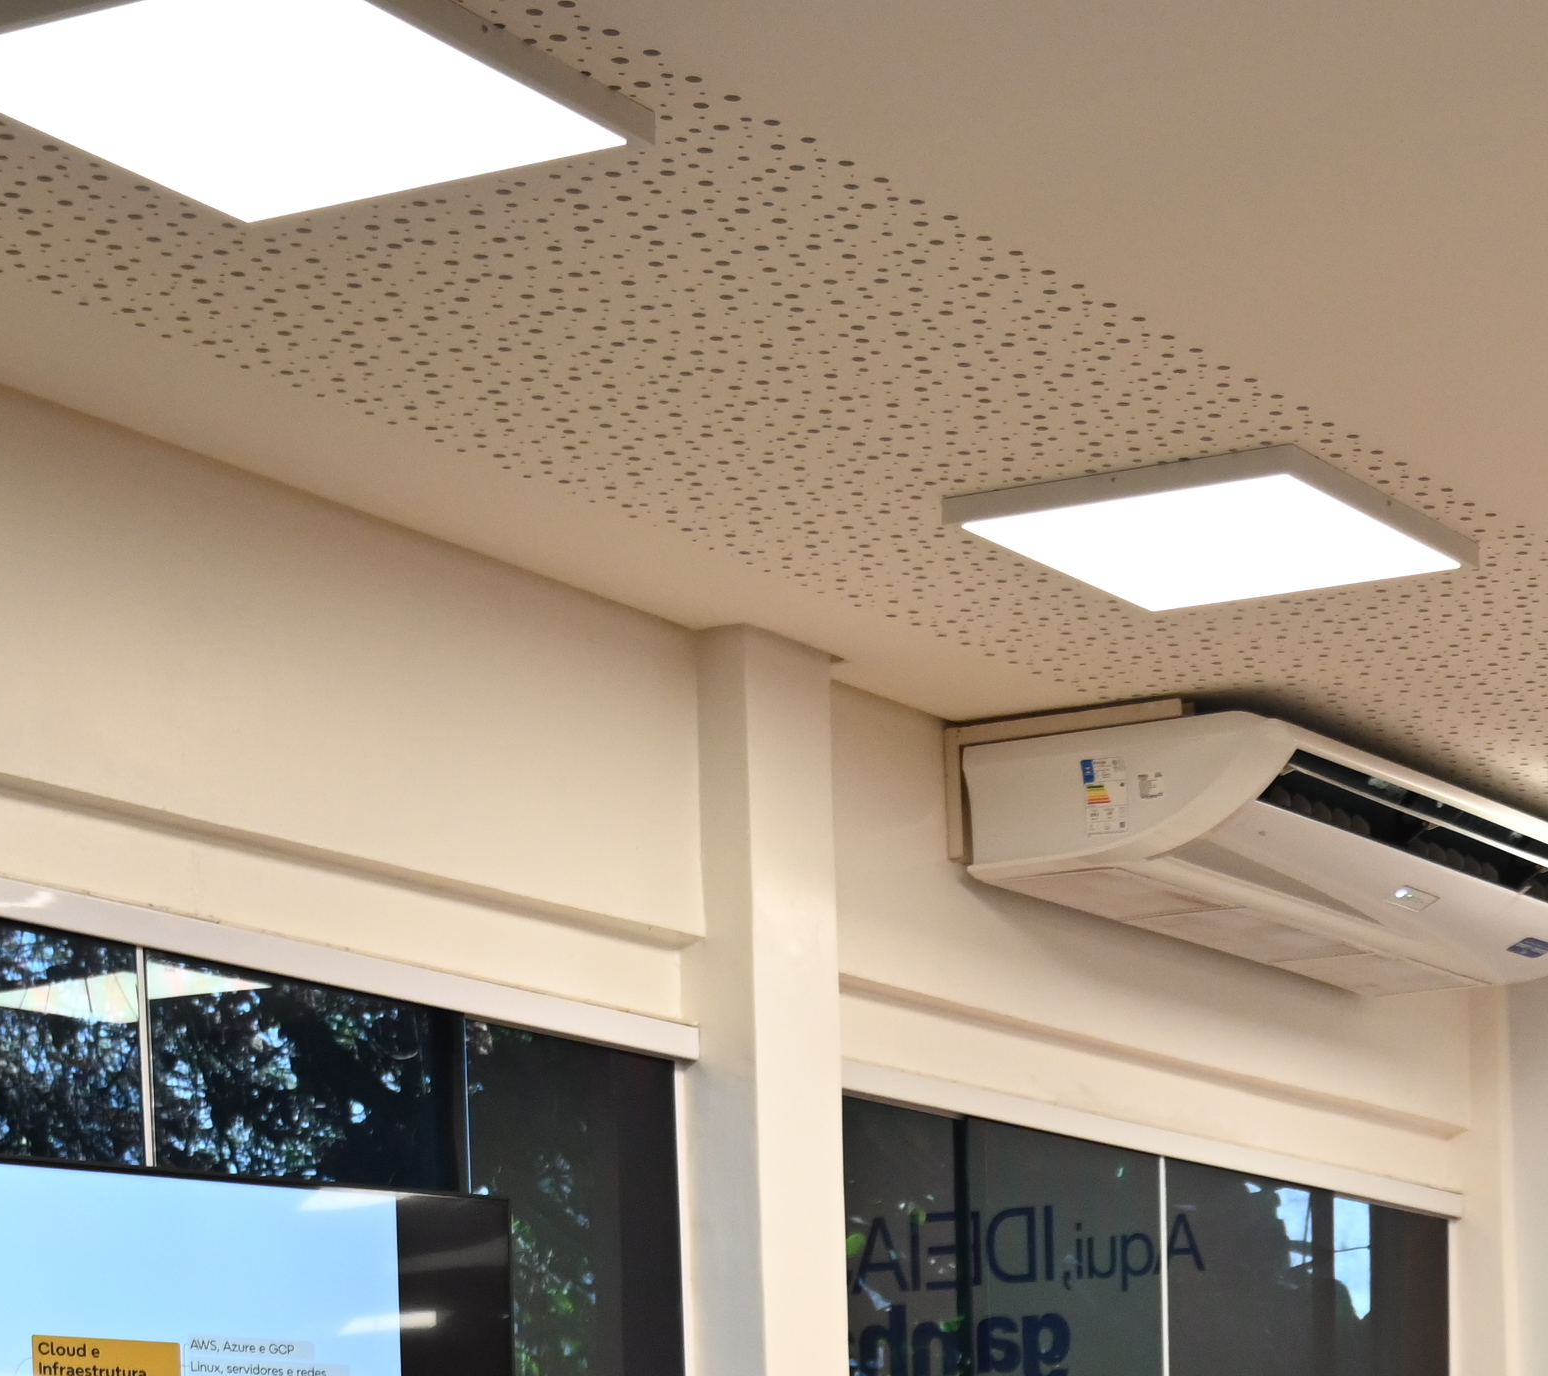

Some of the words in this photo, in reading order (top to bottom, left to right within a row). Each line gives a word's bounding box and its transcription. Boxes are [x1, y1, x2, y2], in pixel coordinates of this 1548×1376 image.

[37, 1341, 87, 1359] Cloud
[91, 1348, 100, 1359] e
[190, 1338, 220, 1354] AWS,
[223, 1341, 256, 1355] Azure
[259, 1345, 266, 1355] e
[268, 1343, 295, 1356] GCP
[190, 1360, 224, 1376] Linux,
[226, 1363, 284, 1376] servidores
